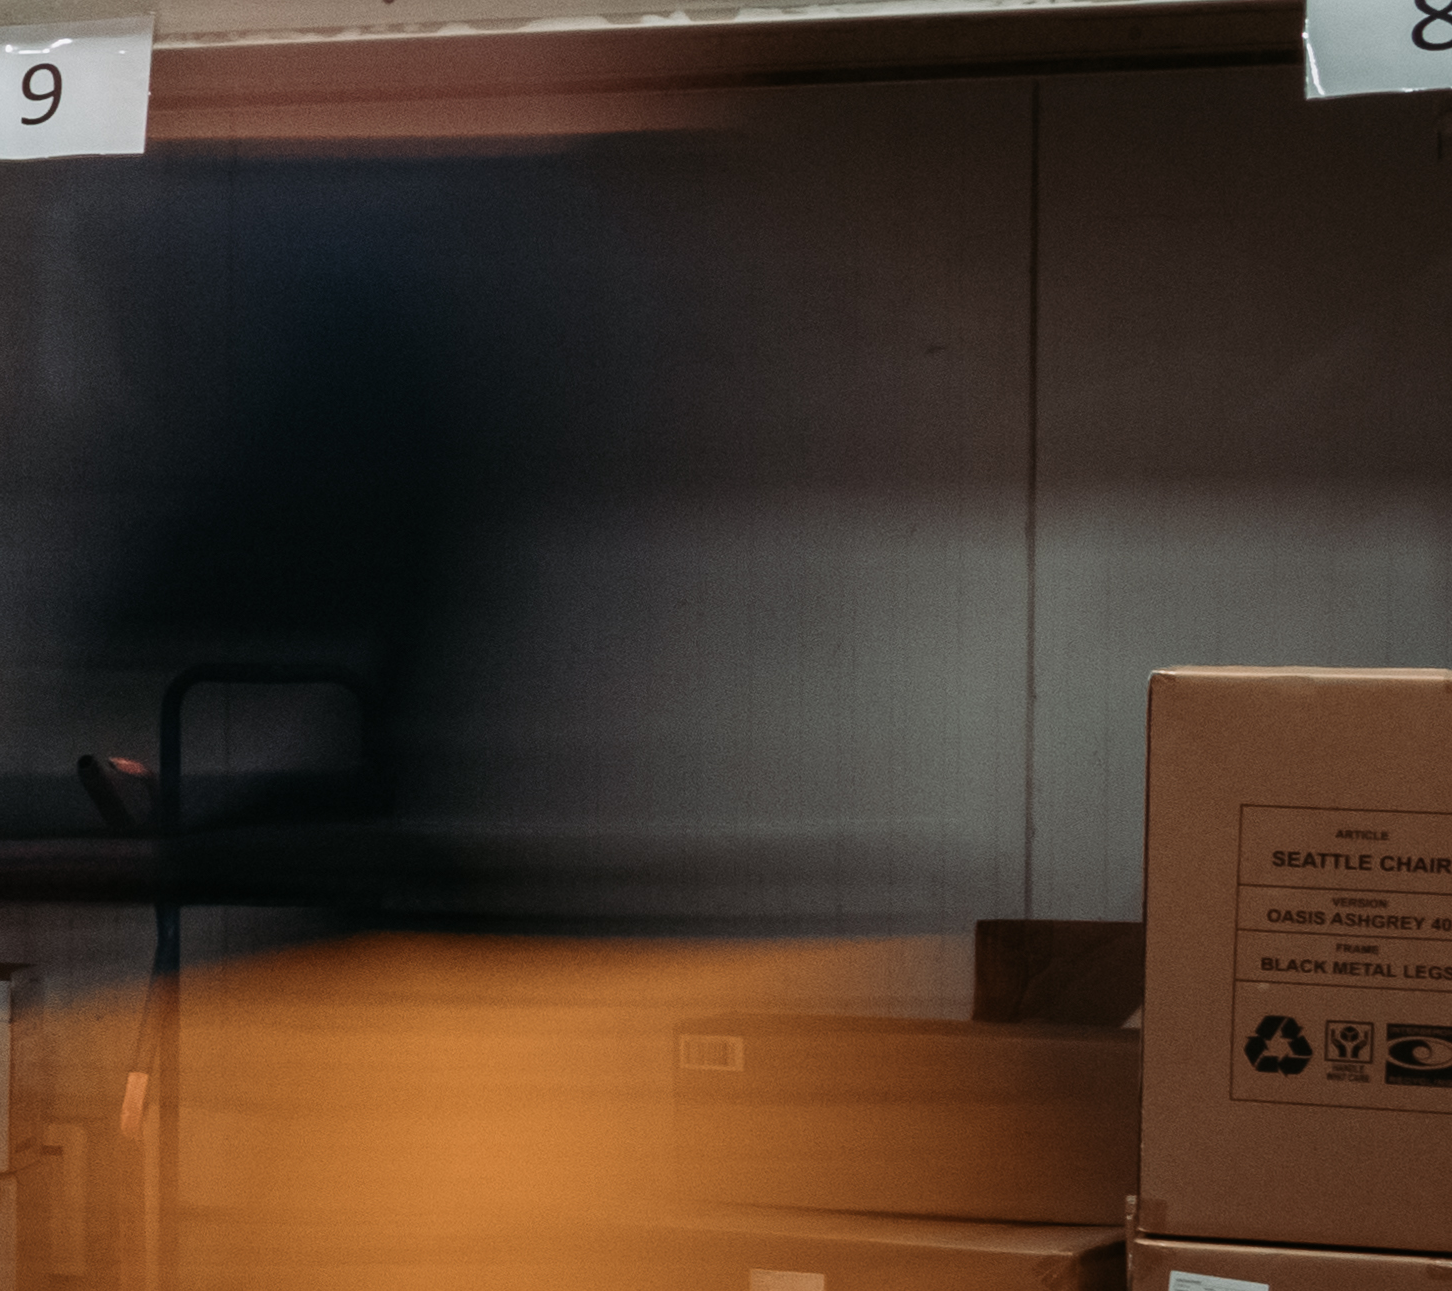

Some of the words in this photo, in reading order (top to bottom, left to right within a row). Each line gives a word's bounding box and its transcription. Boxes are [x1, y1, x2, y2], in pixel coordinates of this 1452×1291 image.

[21, 63, 62, 125] 9
[1335, 830, 1389, 841] ARTICLE
[1272, 850, 1372, 871] SEATTLE
[1379, 855, 1452, 874] CHAIR
[1332, 898, 1389, 909] VERSION
[1267, 909, 1326, 926] OASIS
[1330, 913, 1425, 931] ASHGREY
[1431, 917, 1452, 932] 40
[1335, 943, 1379, 955] FRAME
[1260, 957, 1327, 974] BLACK
[1332, 961, 1397, 978] METAL
[1403, 965, 1452, 981] LEGS
